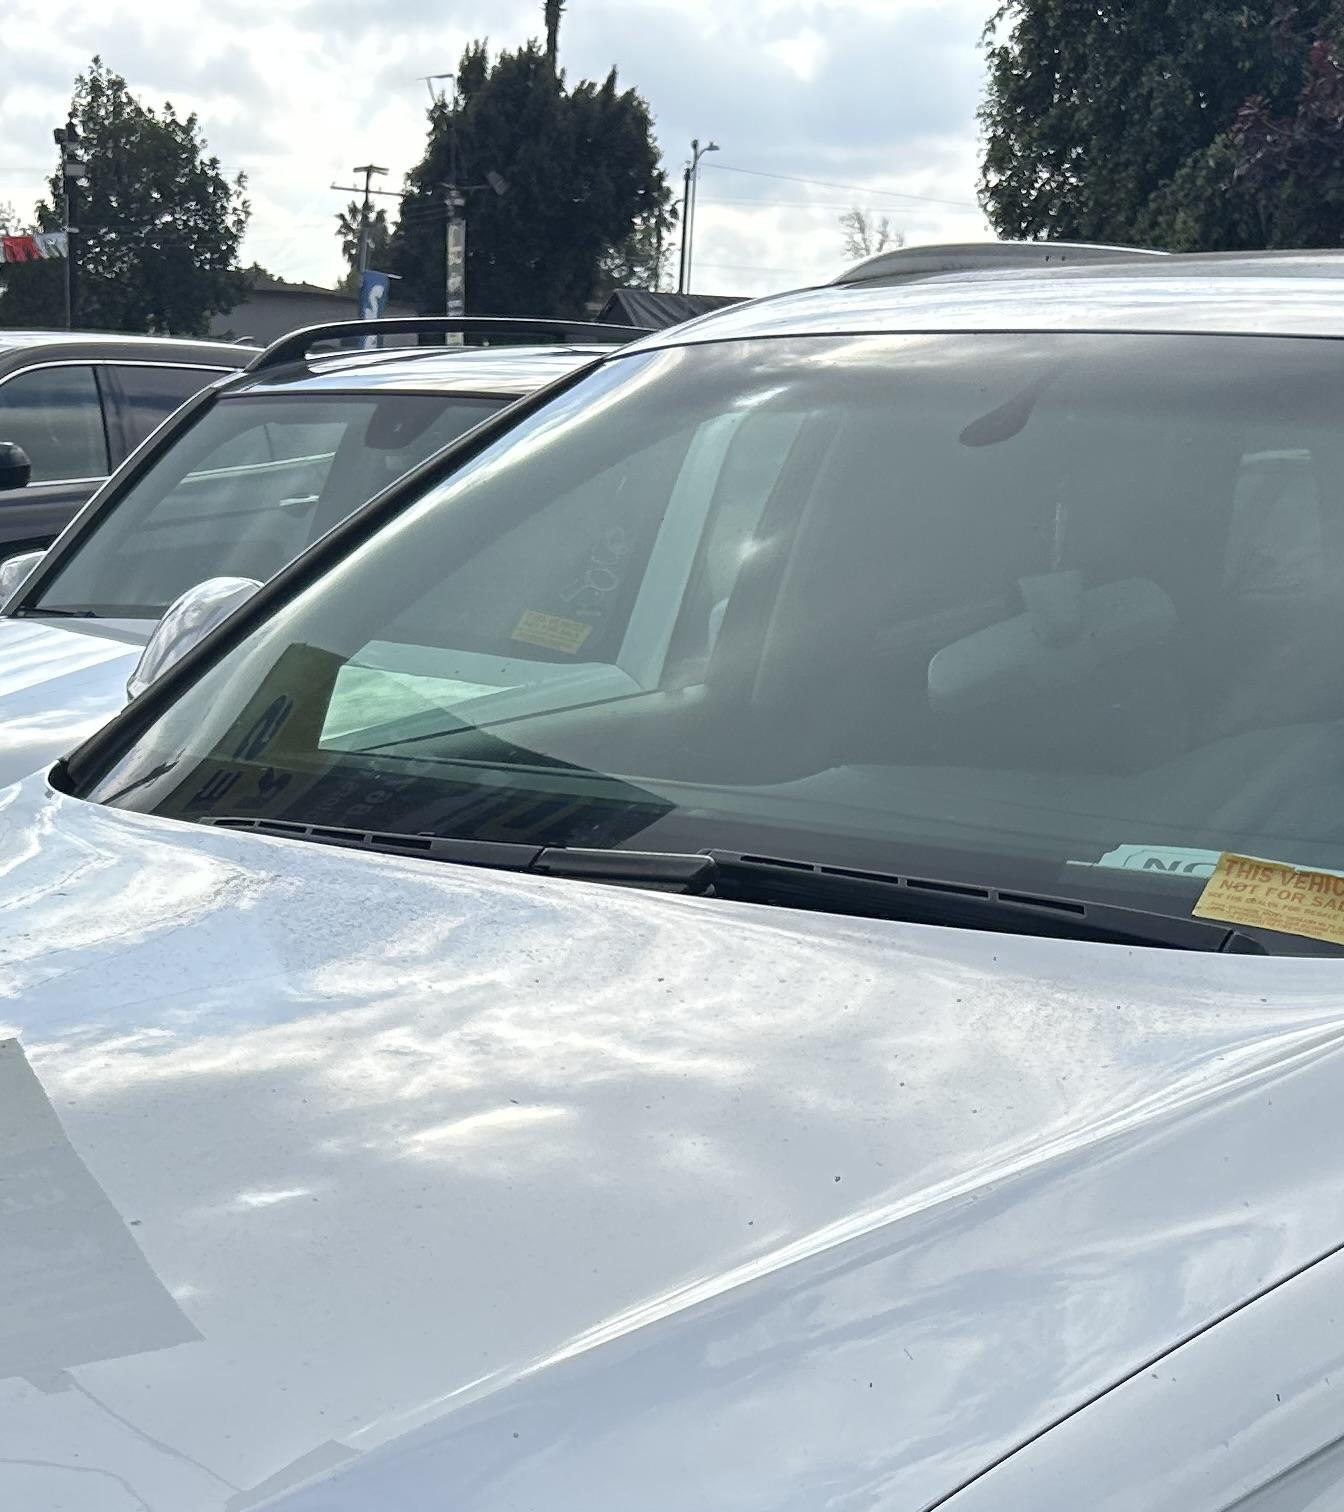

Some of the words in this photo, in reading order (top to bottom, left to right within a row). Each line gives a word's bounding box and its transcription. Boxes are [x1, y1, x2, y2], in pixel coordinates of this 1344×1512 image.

[1224, 859, 1273, 883] THIS
[1219, 878, 1259, 896] NOT
[1265, 887, 1306, 903] FOR
